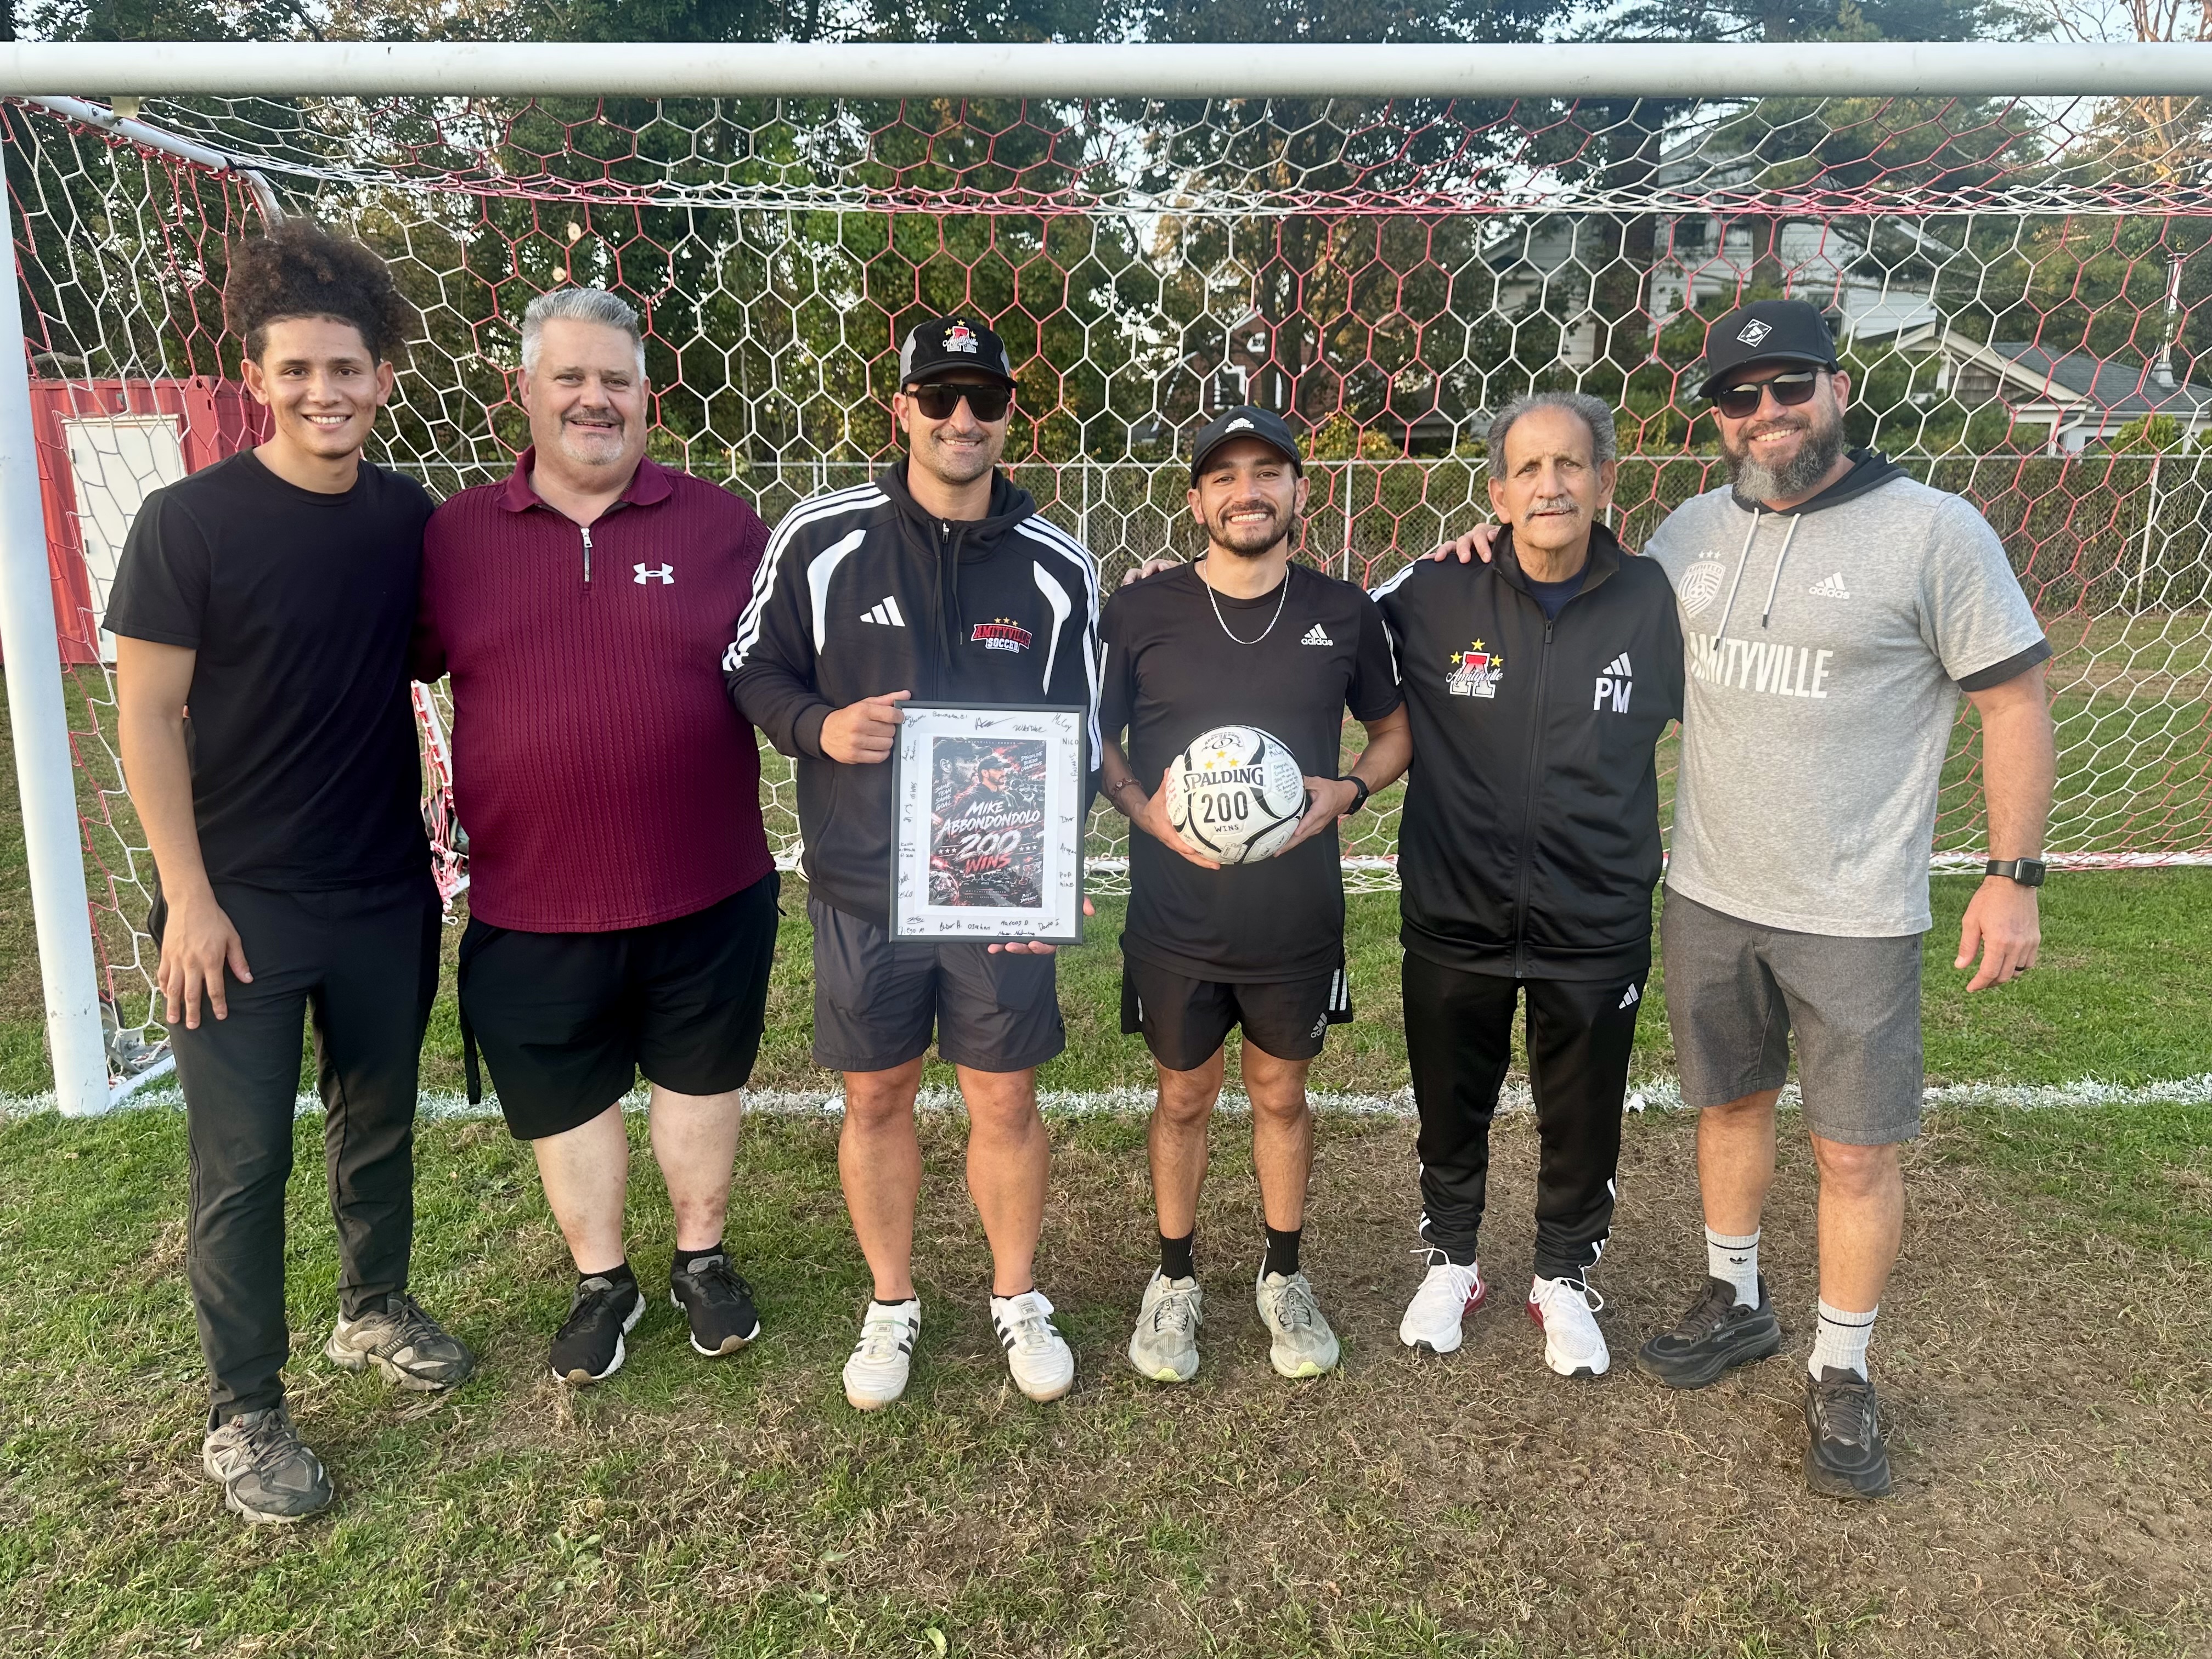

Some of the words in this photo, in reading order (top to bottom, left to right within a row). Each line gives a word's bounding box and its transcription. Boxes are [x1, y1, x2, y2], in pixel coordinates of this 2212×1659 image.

[1809, 586, 1850, 600] adidas
[973, 625, 1030, 645] AMITYVILLE
[987, 637, 1019, 651] SOCCER
[1301, 637, 1334, 646] adidas
[1446, 668, 1504, 688] Amityville
[1593, 677, 1633, 714] PM
[935, 782, 951, 793] SAME
[1183, 767, 1264, 793] SPALDING
[935, 794, 951, 805] SAME
[939, 787, 952, 797] TEAM
[935, 800, 952, 811] GOAL
[964, 800, 1005, 819] MIKE
[1201, 791, 1248, 823] 200
[935, 809, 1041, 839] ABBONDONDOLO
[953, 830, 1022, 863] 200
[964, 852, 1014, 874] WINS
